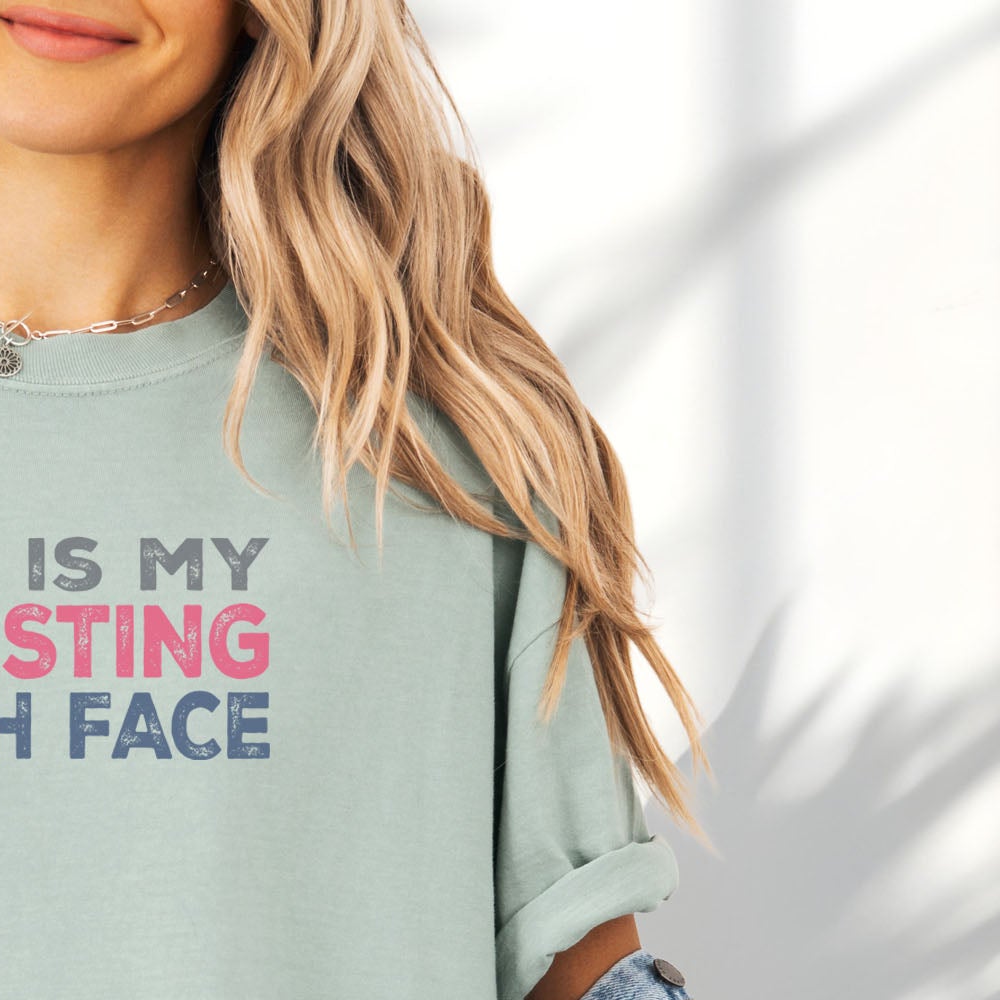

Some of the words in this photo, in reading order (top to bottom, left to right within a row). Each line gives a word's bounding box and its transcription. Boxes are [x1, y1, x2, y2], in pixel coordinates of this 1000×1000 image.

[28, 537, 102, 591] IS
[140, 538, 269, 590] MY
[69, 691, 270, 760] FACE
